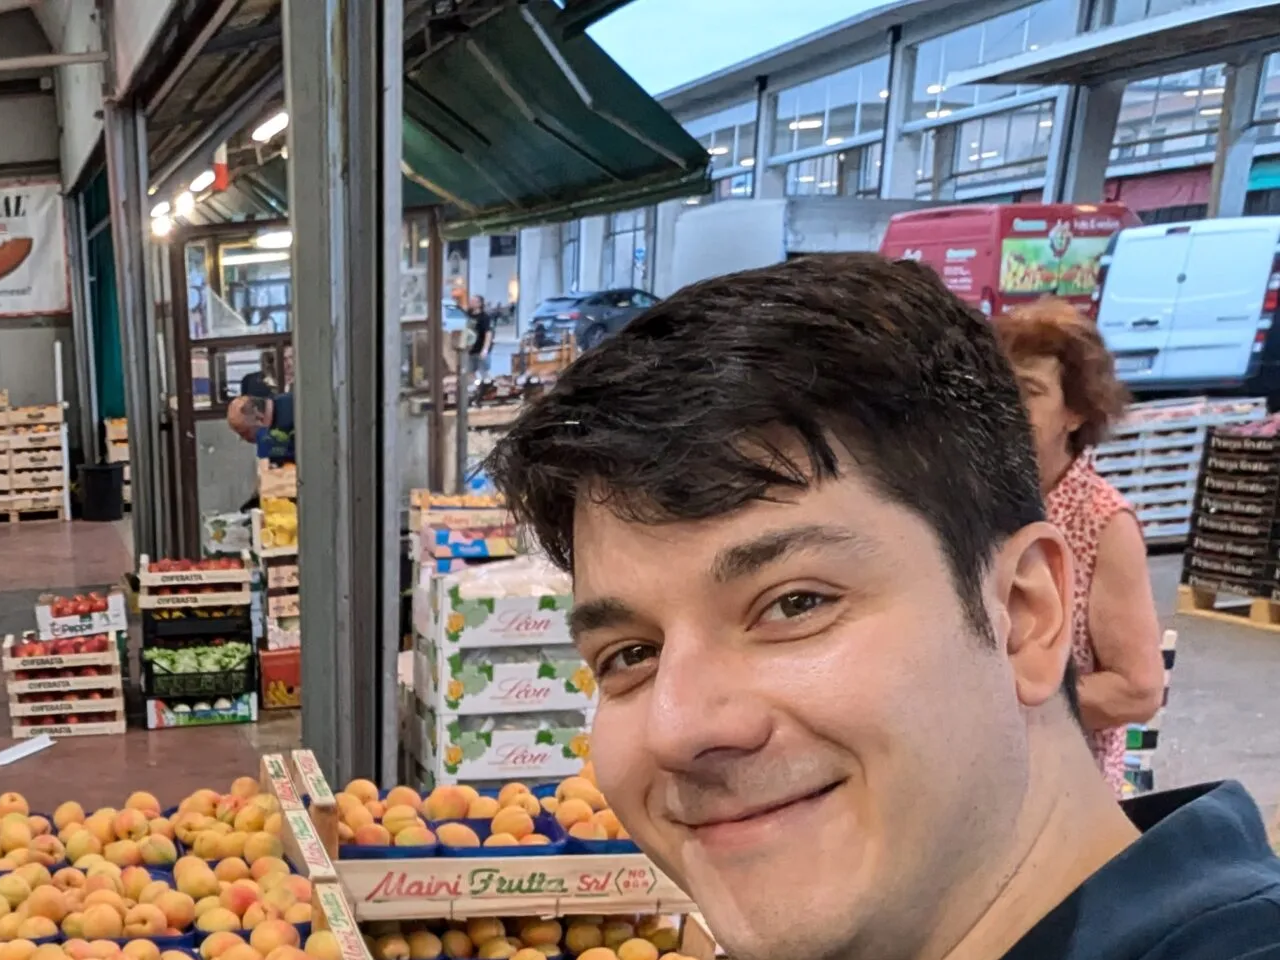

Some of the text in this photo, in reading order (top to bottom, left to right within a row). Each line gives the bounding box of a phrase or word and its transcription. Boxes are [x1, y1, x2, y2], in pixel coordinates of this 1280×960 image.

[366, 868, 612, 901] Maini Frutta Srl
